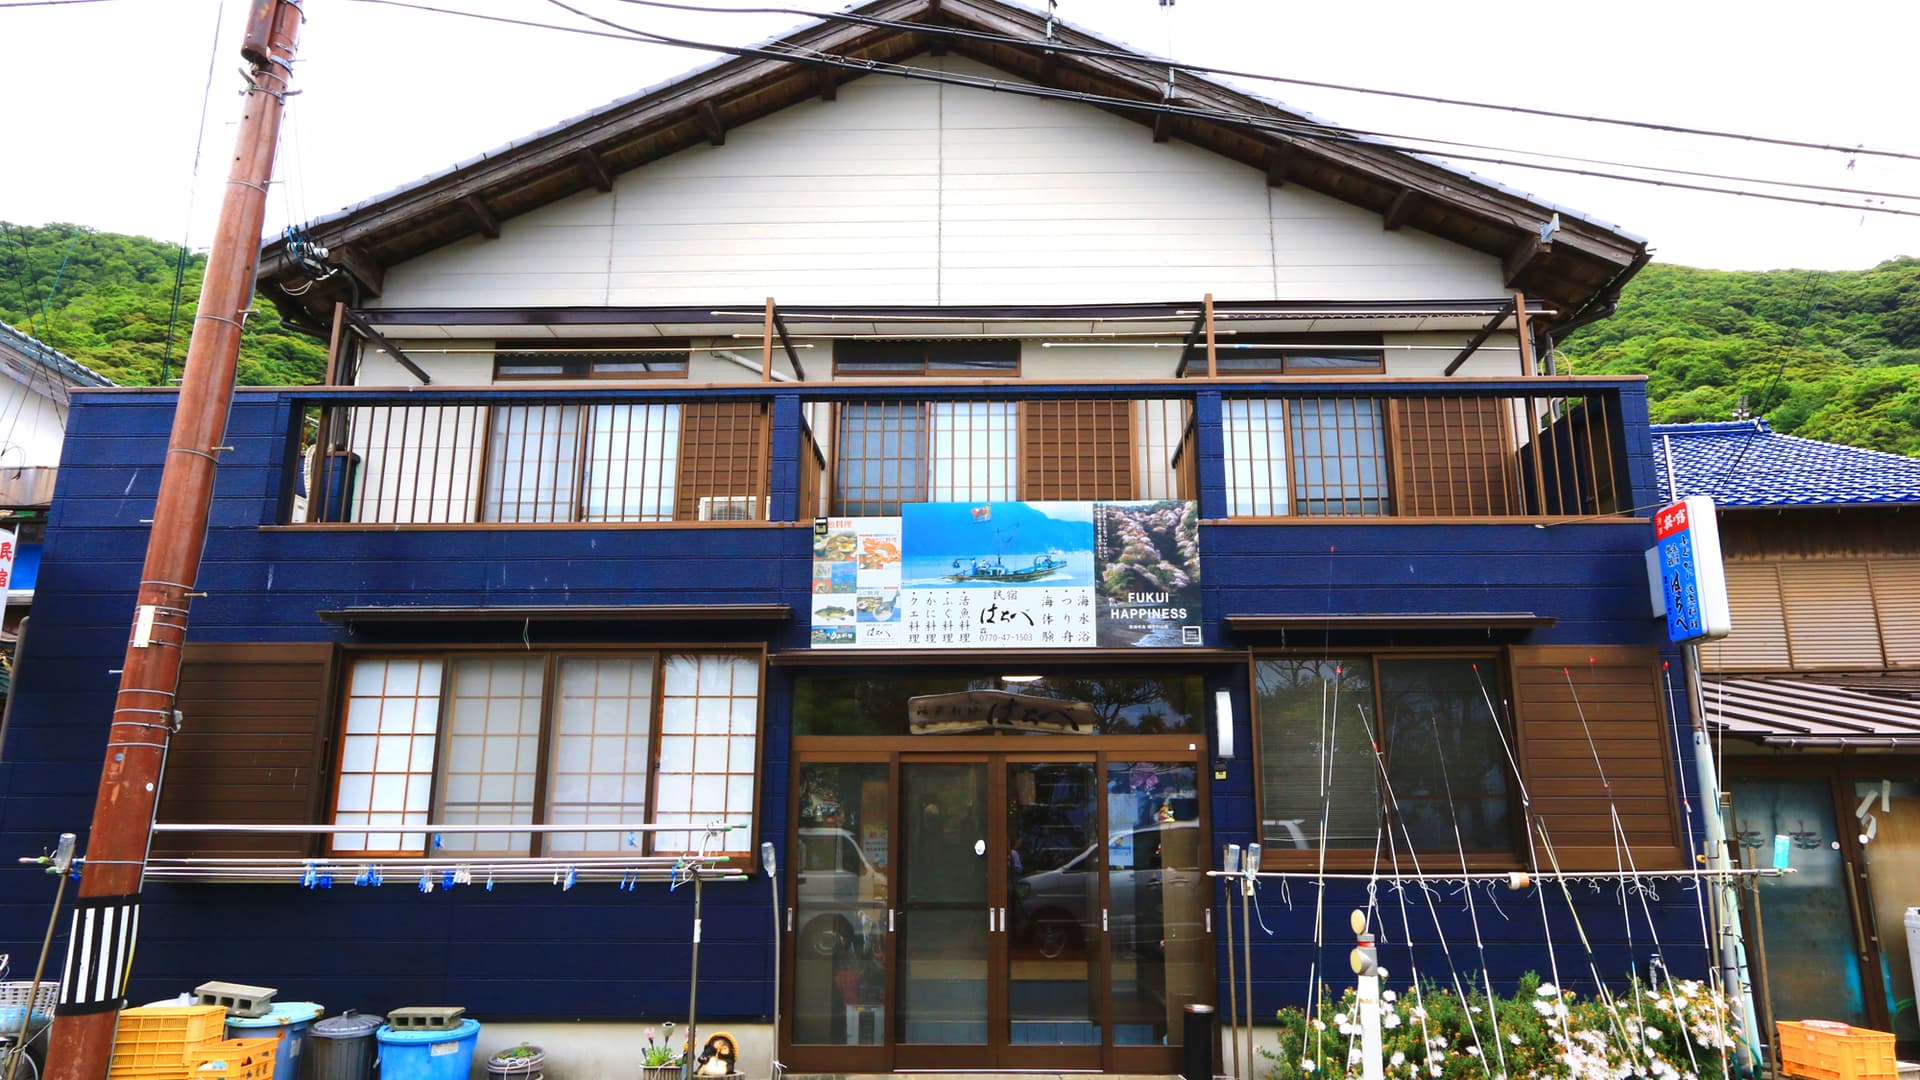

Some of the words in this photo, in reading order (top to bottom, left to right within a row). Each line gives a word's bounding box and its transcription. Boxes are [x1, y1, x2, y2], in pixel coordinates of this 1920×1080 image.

[0, 542, 12, 588] 民宿
[1128, 592, 1169, 604] FUKUI
[1078, 595, 1090, 642] 海水浴
[1110, 608, 1188, 619] HAPPINESS
[979, 633, 1033, 642] 0770-47-1503
